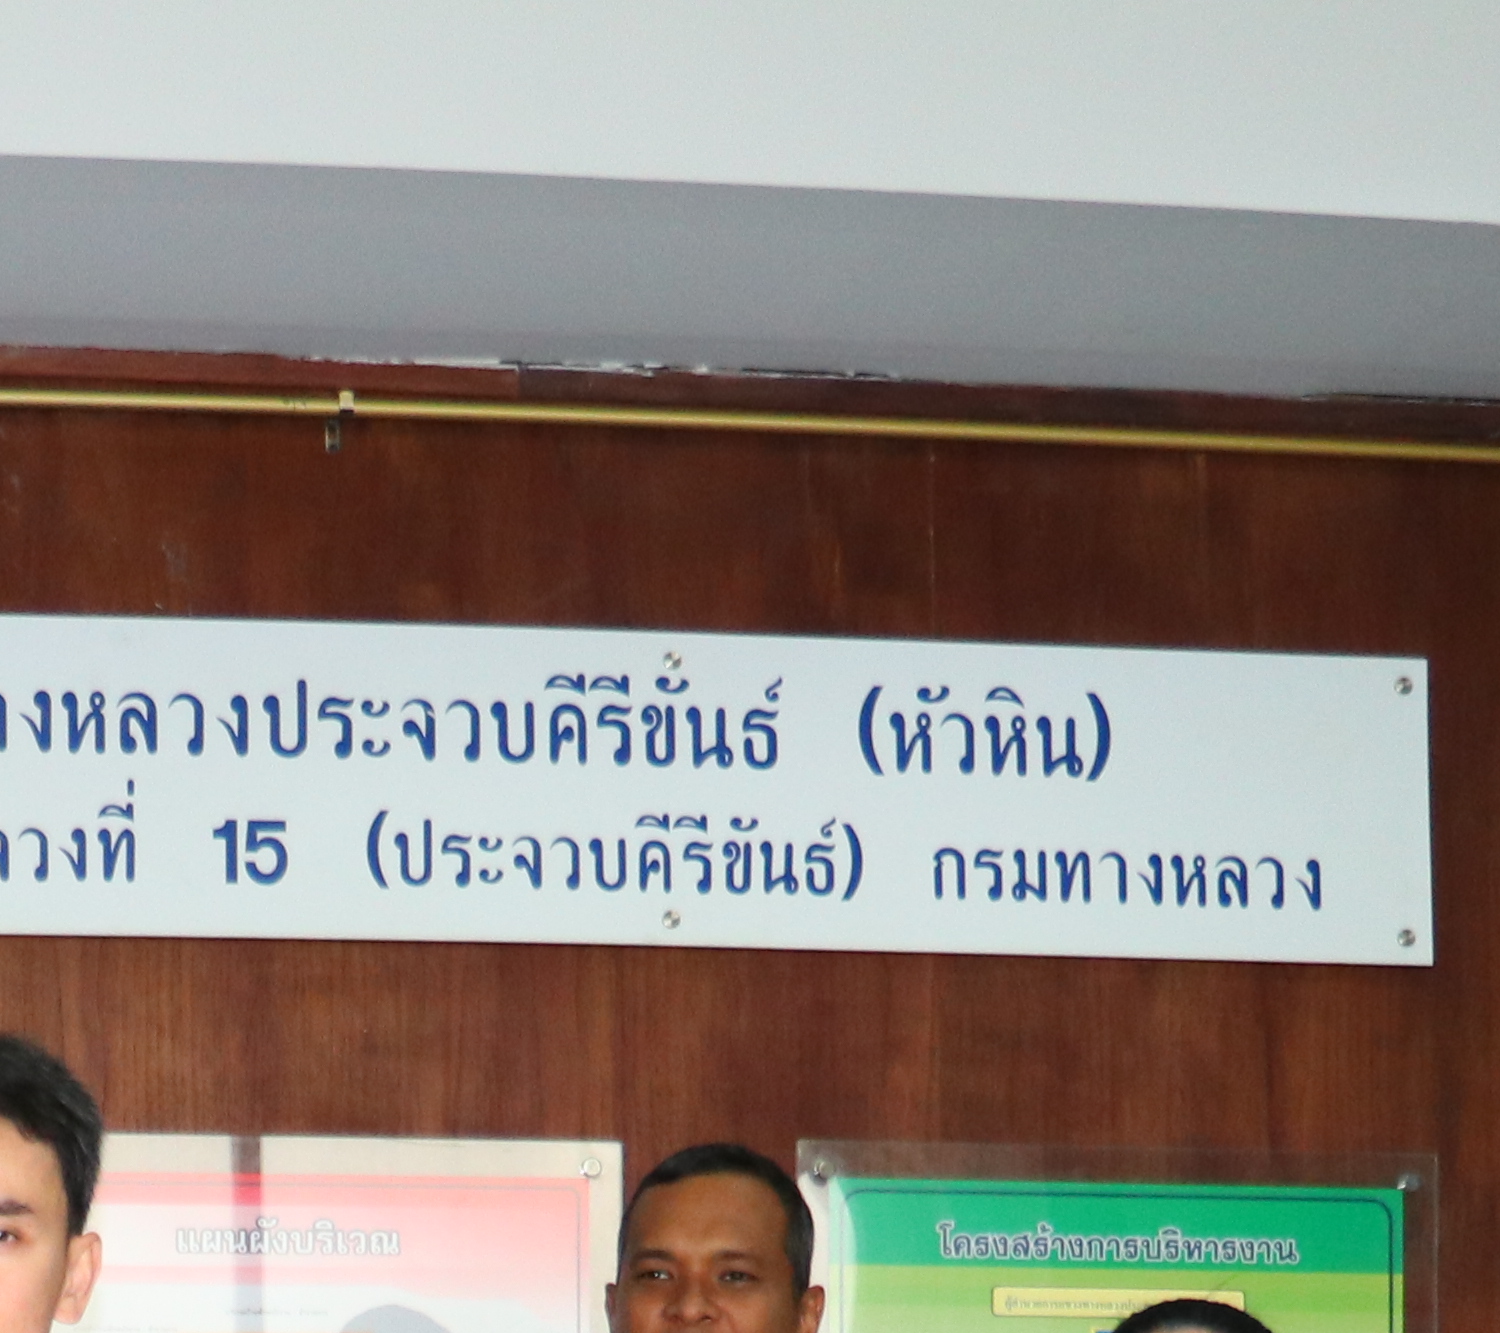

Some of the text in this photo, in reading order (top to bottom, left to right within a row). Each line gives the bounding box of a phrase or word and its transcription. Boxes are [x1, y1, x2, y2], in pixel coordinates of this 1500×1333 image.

[858, 685, 1112, 783] (หัวหิน)
[212, 820, 290, 888] 15
[366, 811, 865, 903] (ประจวบคีรีขันธ์)
[932, 846, 1324, 913] กรมทางหลวง
[174, 1219, 401, 1256] แผนผังบริเวณ
[936, 1222, 1299, 1263] โครงสร้างการบริหารงาน
